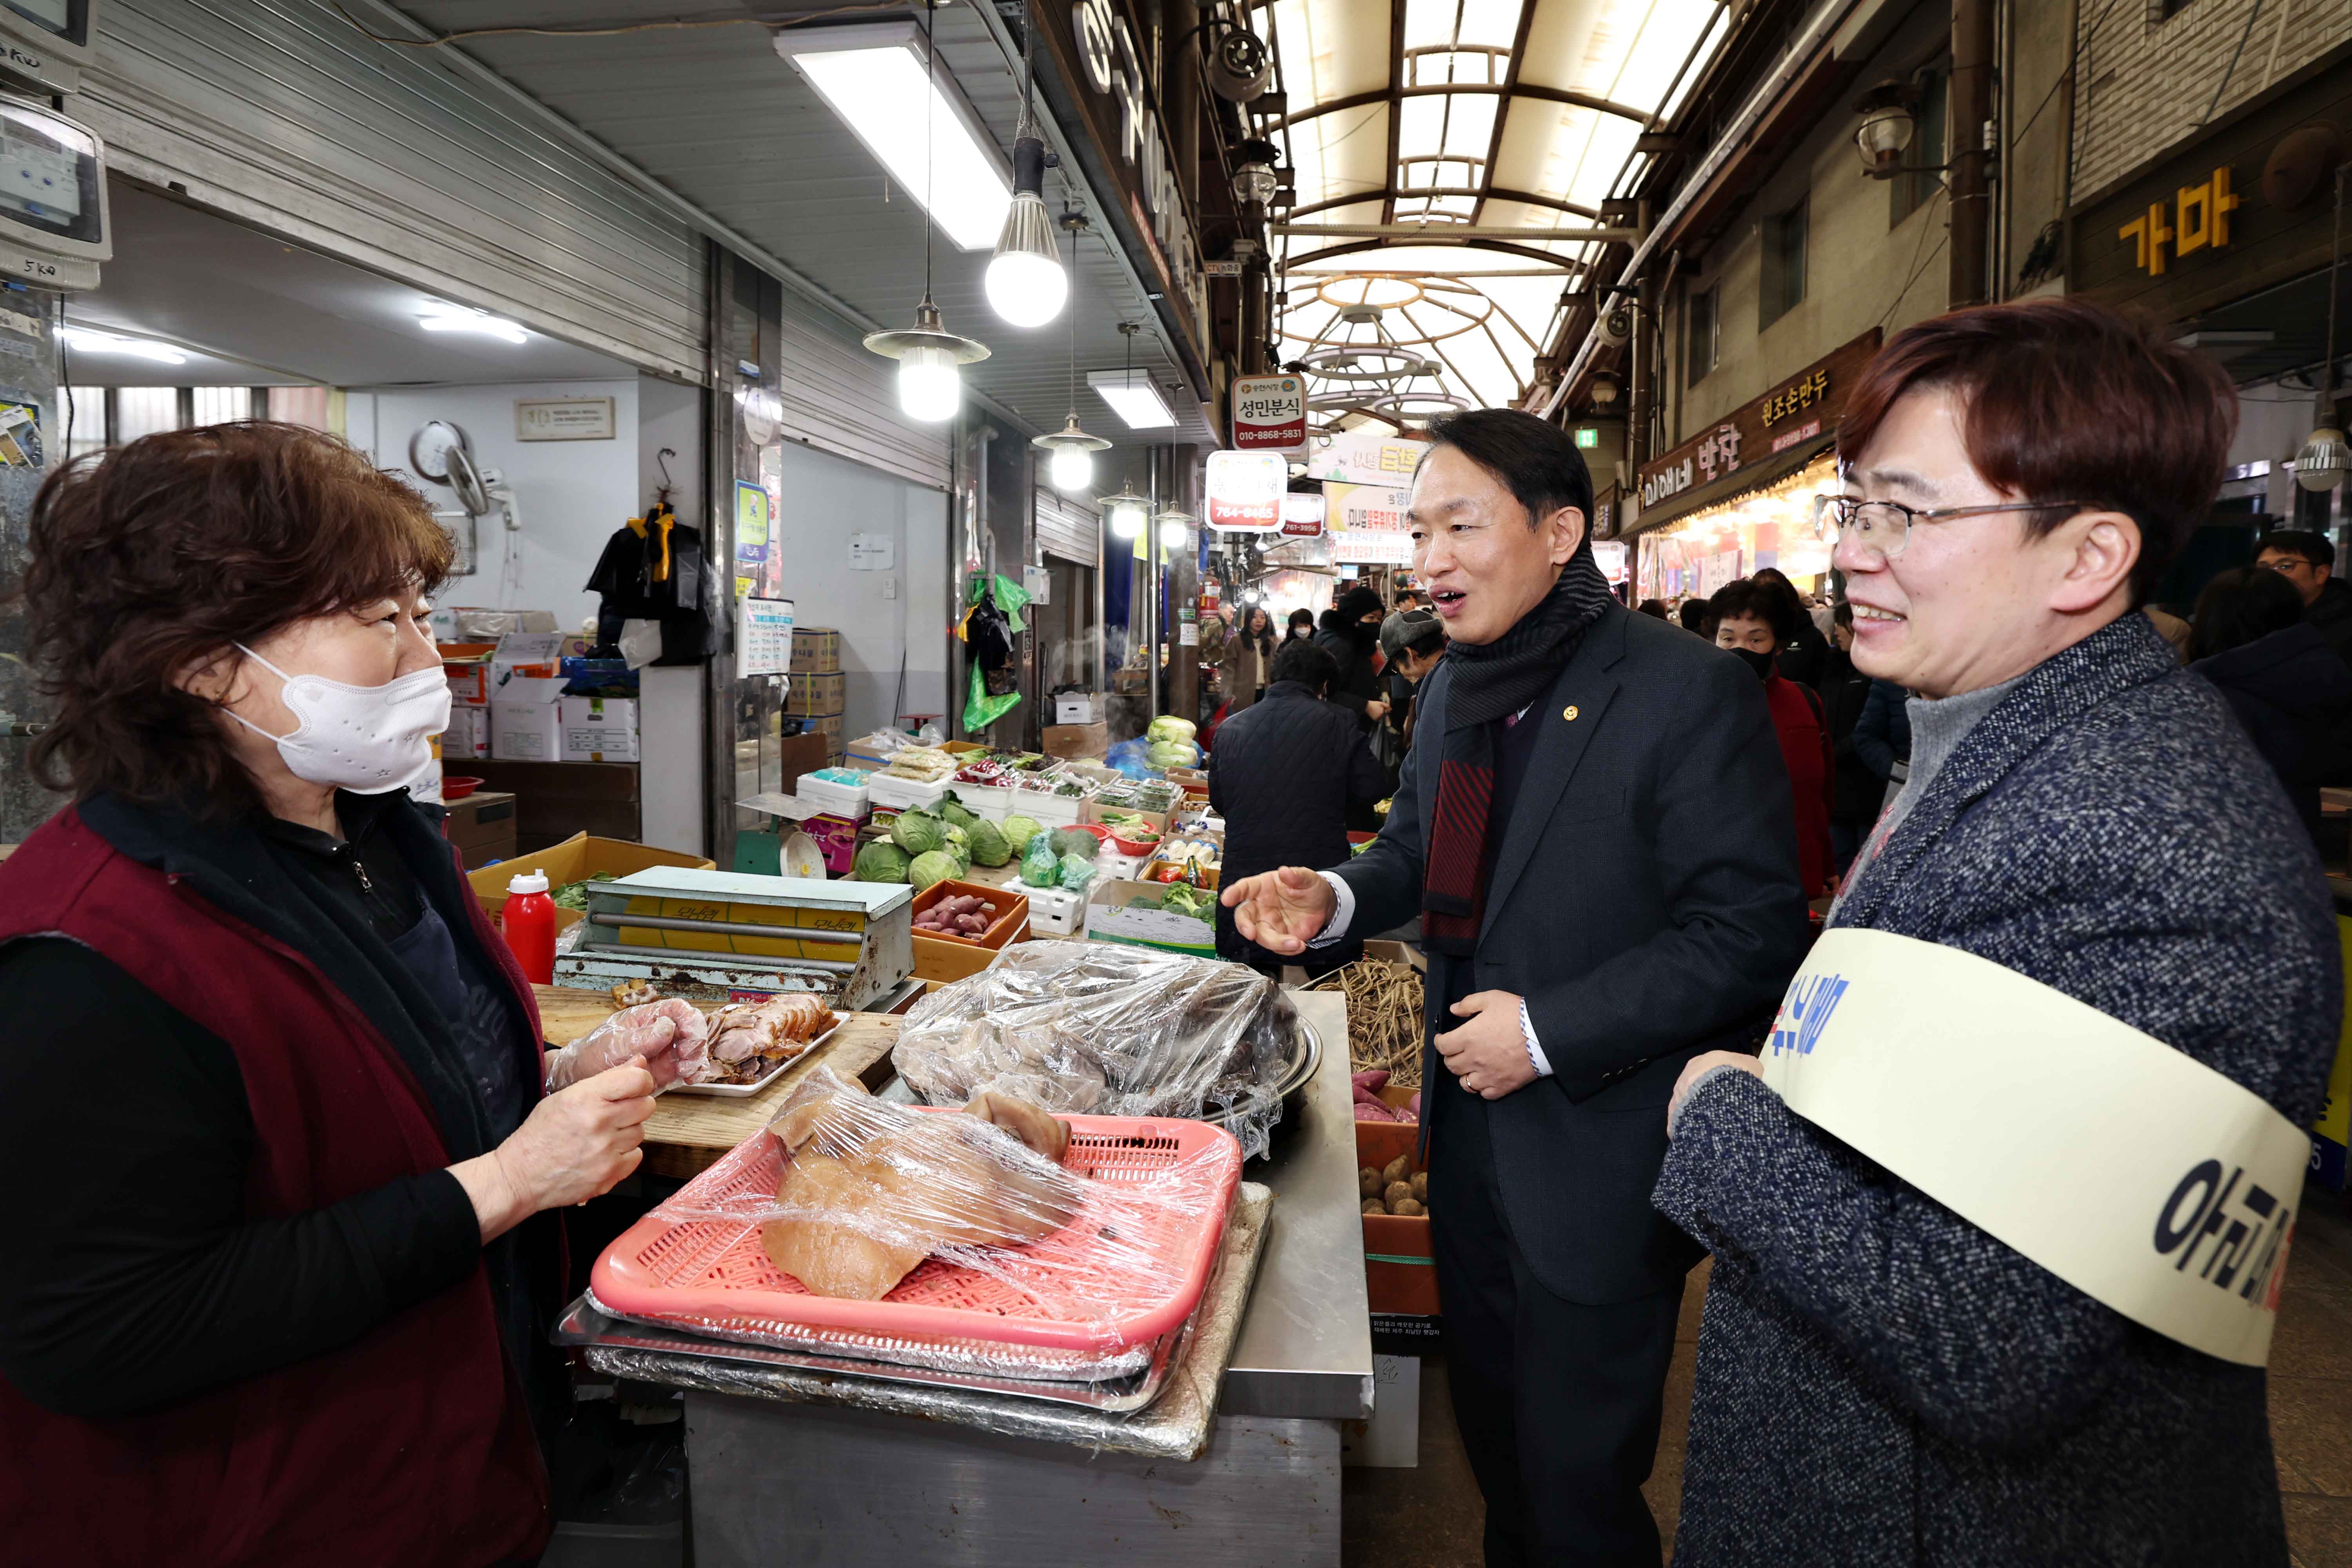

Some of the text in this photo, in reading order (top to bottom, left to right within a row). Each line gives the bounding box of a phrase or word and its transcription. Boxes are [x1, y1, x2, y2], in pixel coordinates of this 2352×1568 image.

[2119, 166, 2239, 276] 가마
[1240, 398, 1299, 418] 성민분식
[1239, 429, 1301, 440] 010-8868-5831
[1699, 423, 1743, 481] 반찬
